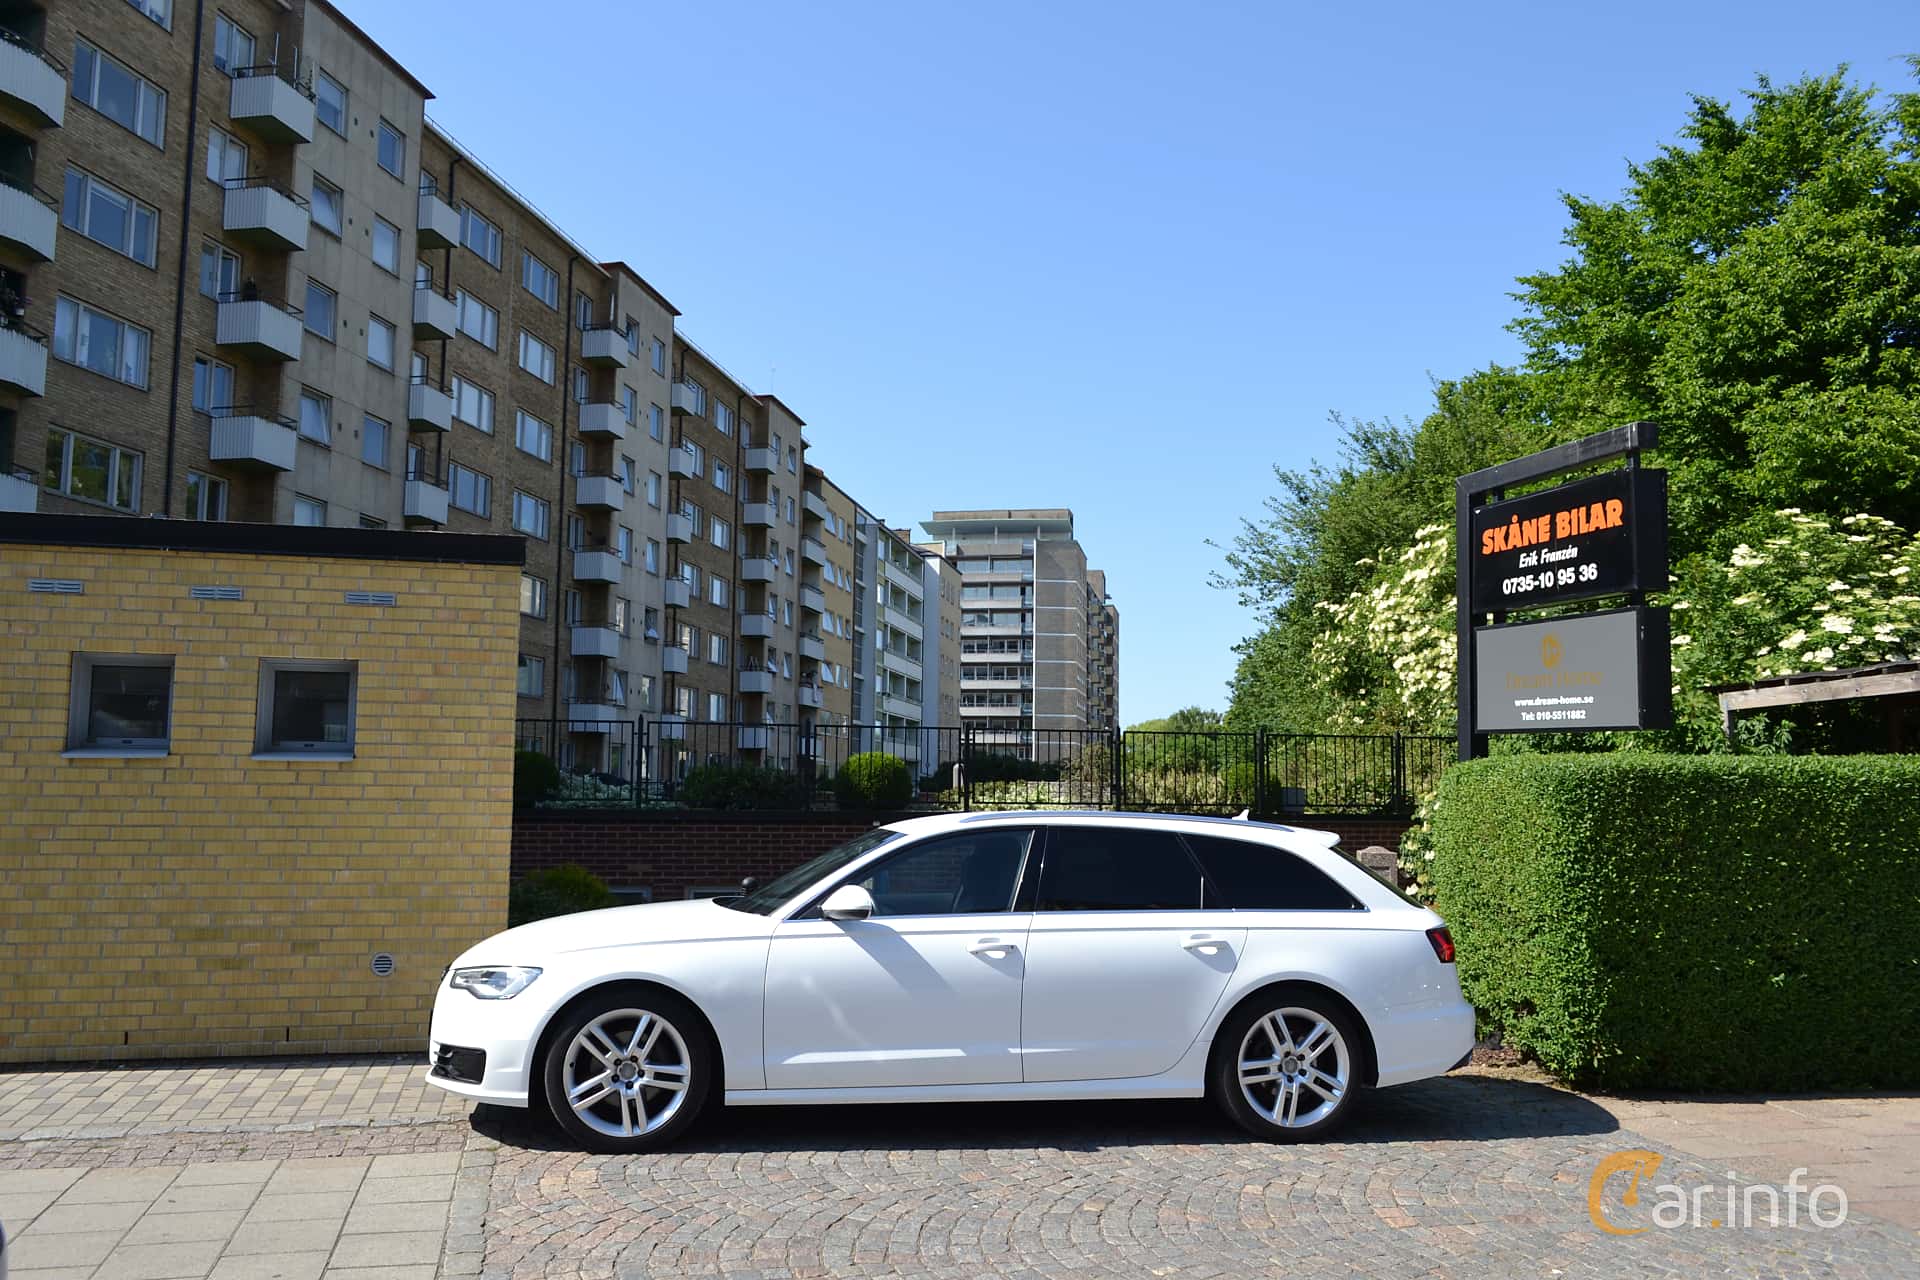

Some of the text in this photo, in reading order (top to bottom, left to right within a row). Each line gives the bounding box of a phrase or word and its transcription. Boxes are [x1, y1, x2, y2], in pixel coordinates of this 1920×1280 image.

[1482, 499, 1623, 555] SKÅNE BILAR
[1519, 545, 1578, 568] Erik Franzén
[1502, 563, 1598, 594] 0735-10 95 36
[1514, 696, 1594, 706] www.dream-home.se
[1521, 712, 1535, 720] Tel:
